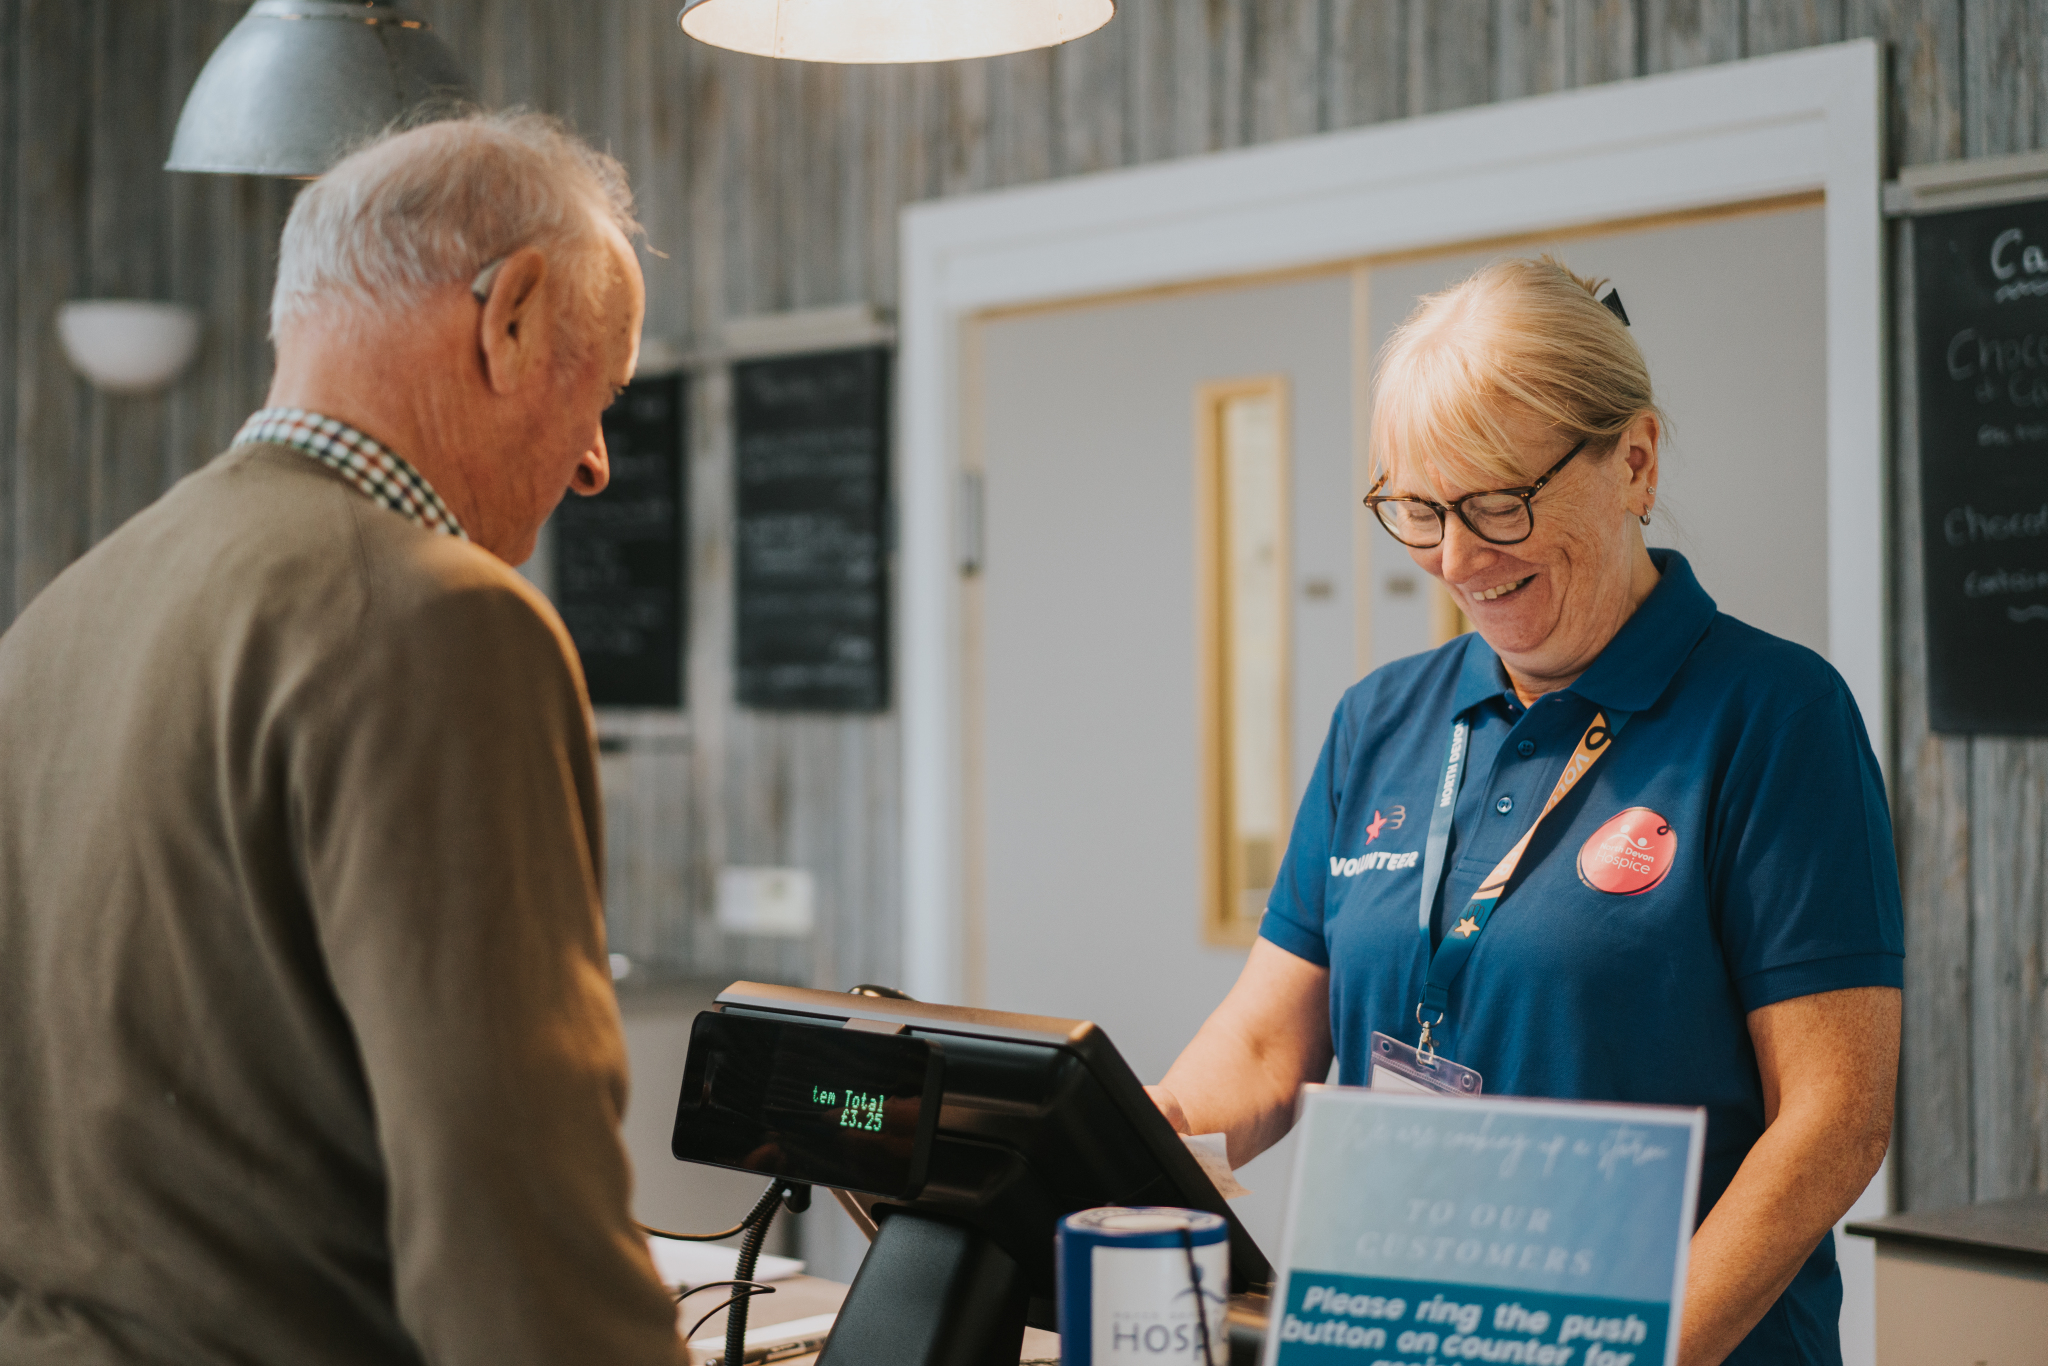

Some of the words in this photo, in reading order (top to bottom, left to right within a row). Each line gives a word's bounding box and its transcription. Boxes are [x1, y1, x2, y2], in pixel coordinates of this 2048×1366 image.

[1440, 763, 1458, 808] NORTH
[1449, 718, 1464, 763] DEVON
[1330, 851, 1419, 877] VOLUNTEER
[1595, 850, 1650, 875] Hospice
[1600, 842, 1624, 853] North
[1625, 848, 1654, 863] Devon
[813, 1085, 836, 1106] tem
[845, 1089, 885, 1113] Total
[840, 1108, 884, 1132] £3.25
[1405, 1197, 1456, 1228] TO
[1469, 1202, 1553, 1235] OUR
[1355, 1230, 1595, 1275] CUSTOMERS
[1301, 1286, 1407, 1320] Please
[1415, 1294, 1483, 1335] ring
[1493, 1302, 1551, 1334] the
[1558, 1314, 1648, 1346] push
[1279, 1314, 1387, 1350] button
[1396, 1330, 1440, 1354] on
[1441, 1333, 1575, 1366] counter
[1583, 1341, 1636, 1366] for
